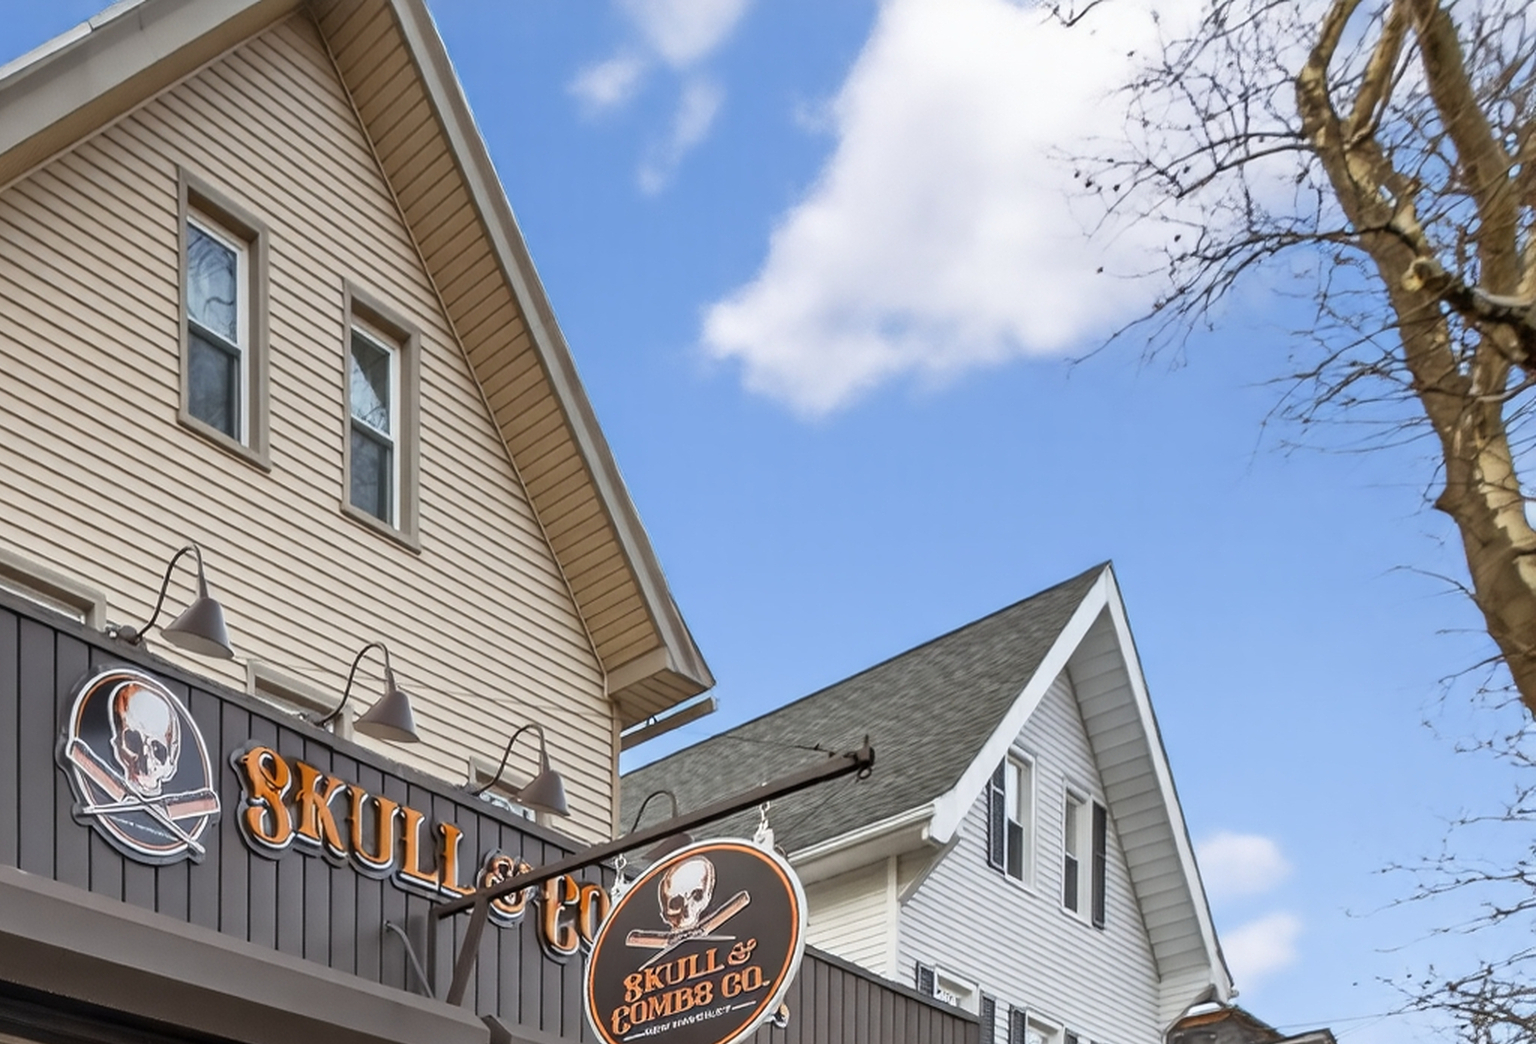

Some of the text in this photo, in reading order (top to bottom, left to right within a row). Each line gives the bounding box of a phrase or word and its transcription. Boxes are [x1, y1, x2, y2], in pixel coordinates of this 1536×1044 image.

[239, 746, 476, 899] SKULL
[611, 965, 771, 1036] COMBS CO.
[622, 938, 758, 1003] SKULL &
